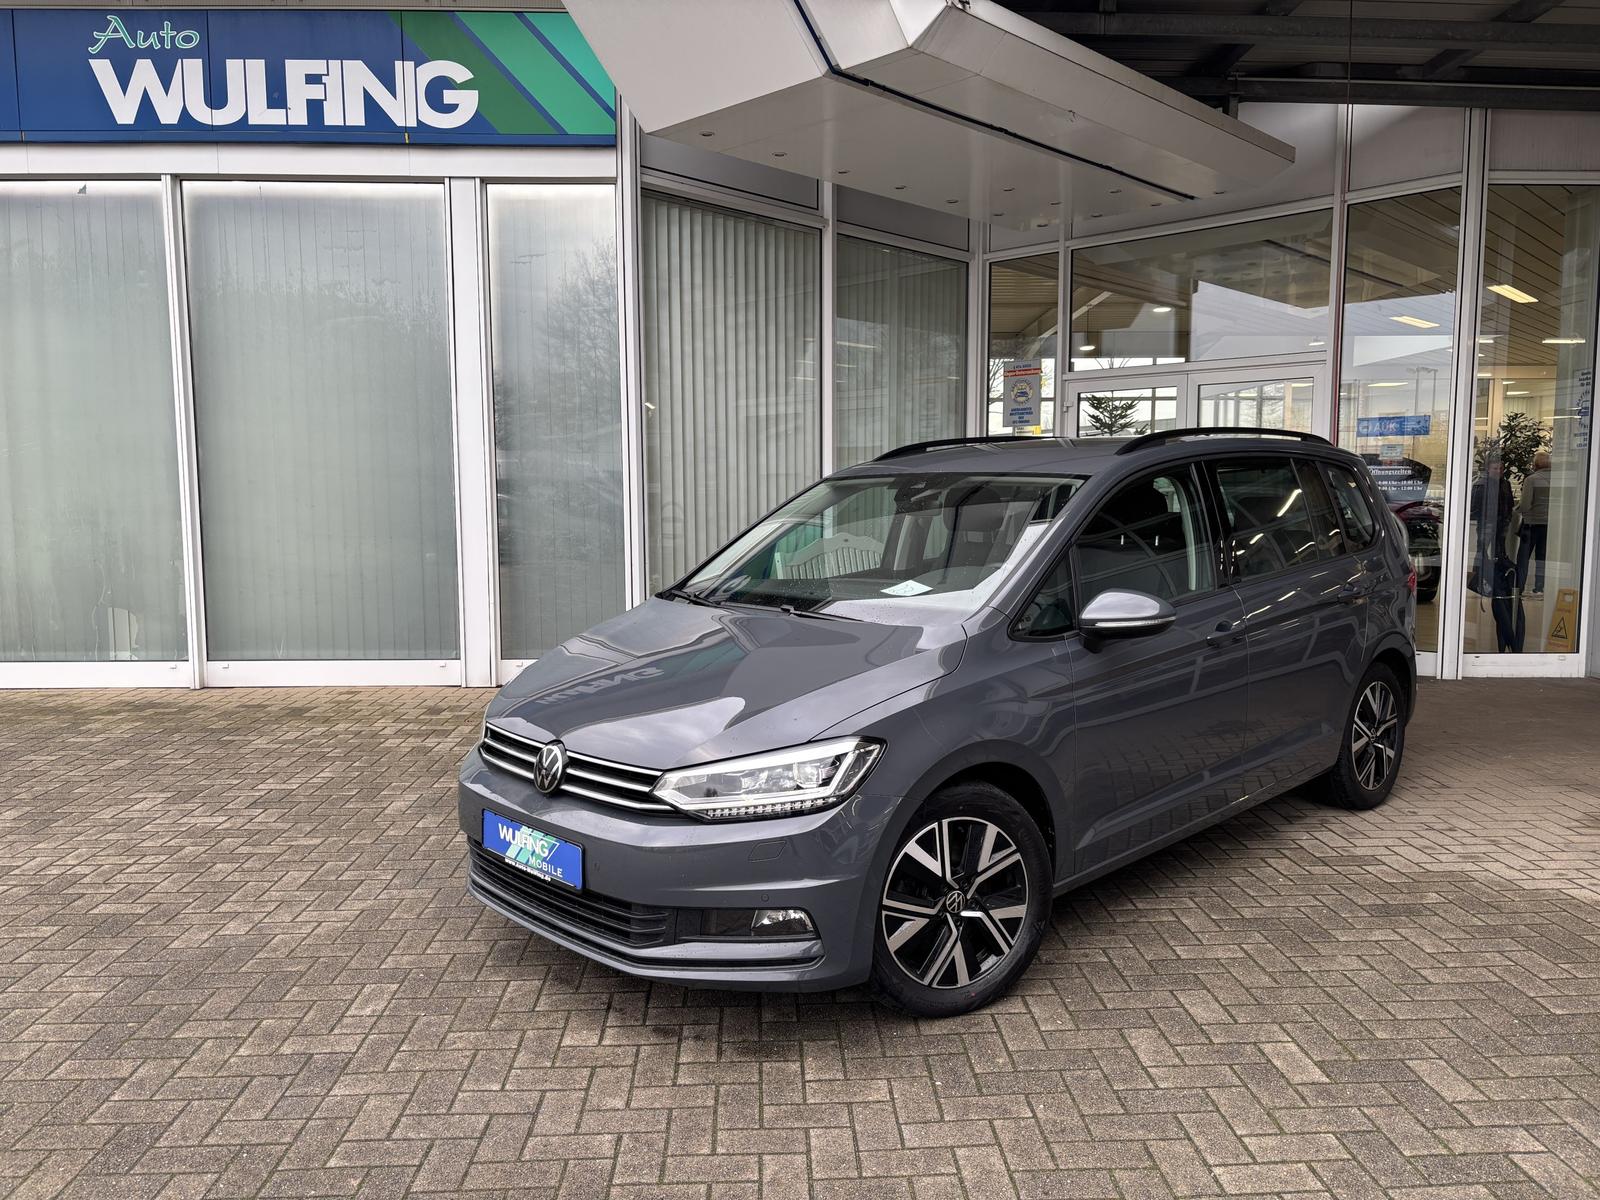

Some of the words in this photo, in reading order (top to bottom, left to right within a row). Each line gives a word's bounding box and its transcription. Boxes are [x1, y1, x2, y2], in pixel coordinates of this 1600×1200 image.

[88, 15, 200, 53] Auto
[88, 59, 479, 129] WULFING
[498, 823, 549, 858] WULFING
[529, 855, 563, 878] MOBILE
